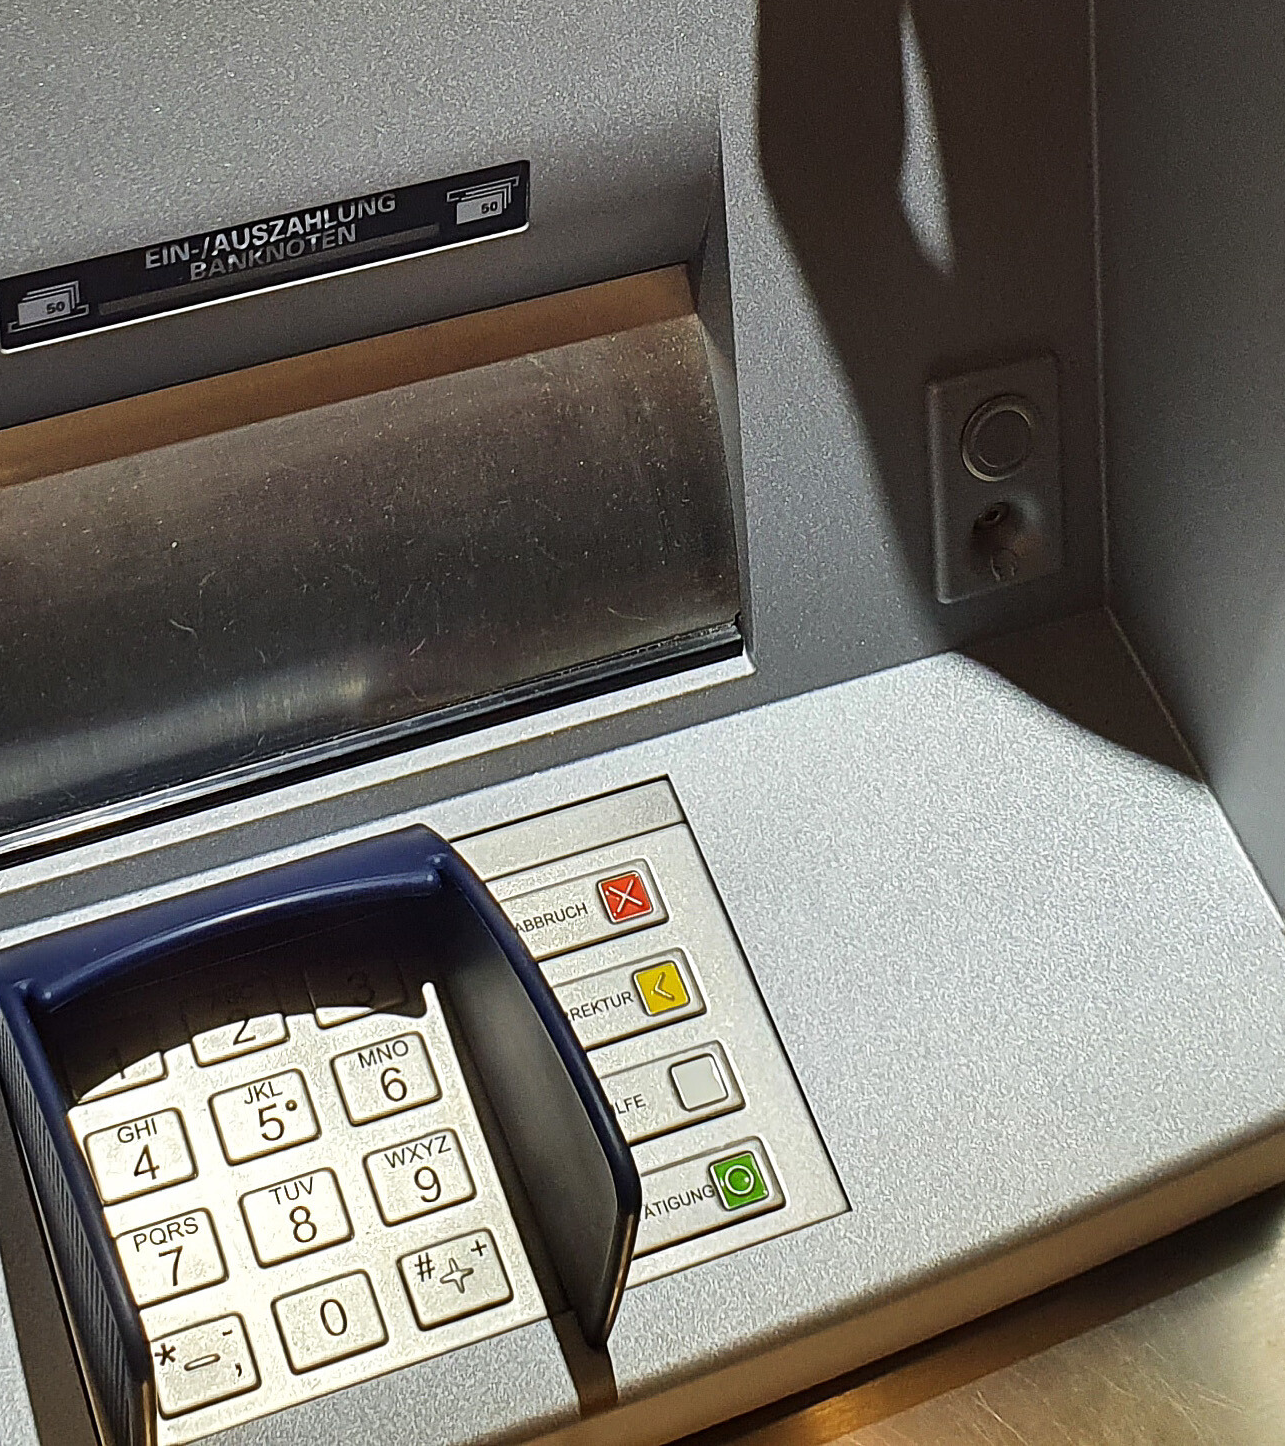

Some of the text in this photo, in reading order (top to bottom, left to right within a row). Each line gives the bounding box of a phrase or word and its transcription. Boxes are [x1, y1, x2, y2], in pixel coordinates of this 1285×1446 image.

[481, 199, 499, 215] 50
[144, 193, 397, 270] EIN-/AUSZAHLUNG
[189, 223, 357, 282] BANKNOTEN
[46, 299, 66, 316] 50
[565, 991, 634, 1021] REKTUR
[357, 1039, 409, 1069] MNO
[244, 1081, 284, 1105] JKL
[380, 1068, 407, 1101] 6
[614, 1094, 646, 1114] LFE
[117, 1118, 158, 1144] GHI
[258, 1104, 285, 1141] 5
[133, 1145, 160, 1180] 4
[384, 1135, 452, 1170] WXYZ
[269, 1177, 314, 1206] TUV
[414, 1166, 442, 1202] 9
[133, 1217, 199, 1252] PQRS
[289, 1206, 317, 1243] 8
[158, 1246, 184, 1287] 7
[320, 1299, 347, 1336] 0
